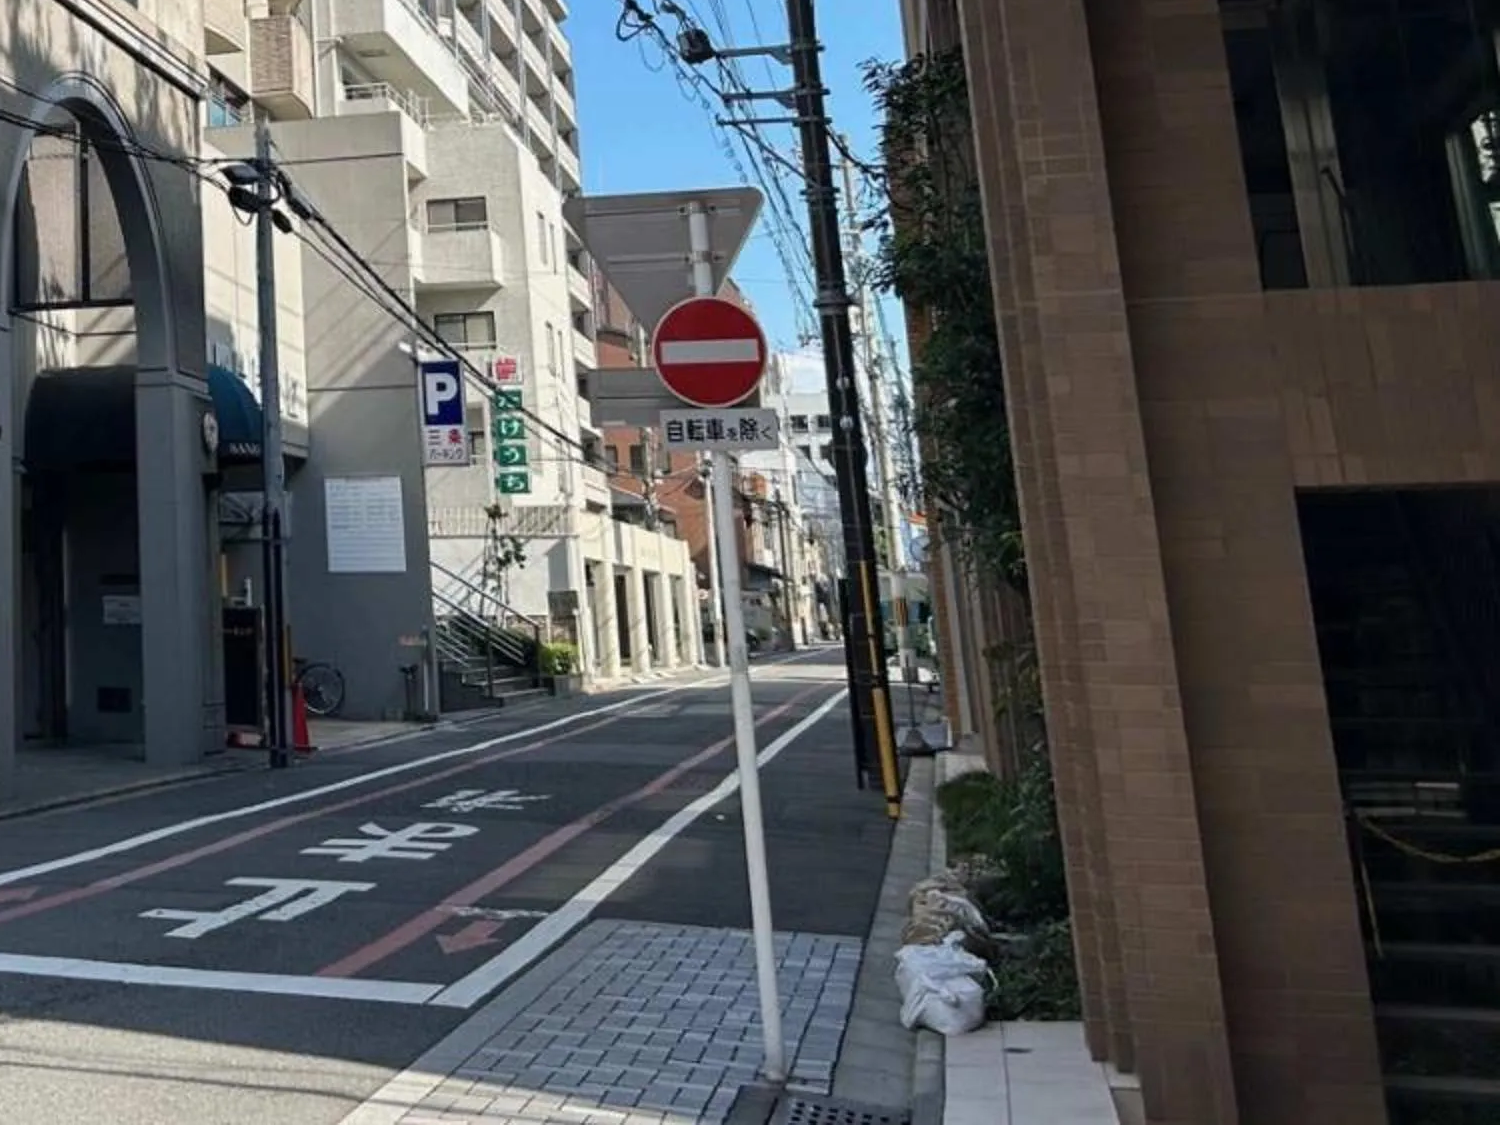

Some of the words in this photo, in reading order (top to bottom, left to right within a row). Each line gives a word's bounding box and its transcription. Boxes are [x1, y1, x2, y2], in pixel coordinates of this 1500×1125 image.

[425, 372, 458, 416] P
[666, 418, 773, 443] 自転車を除く
